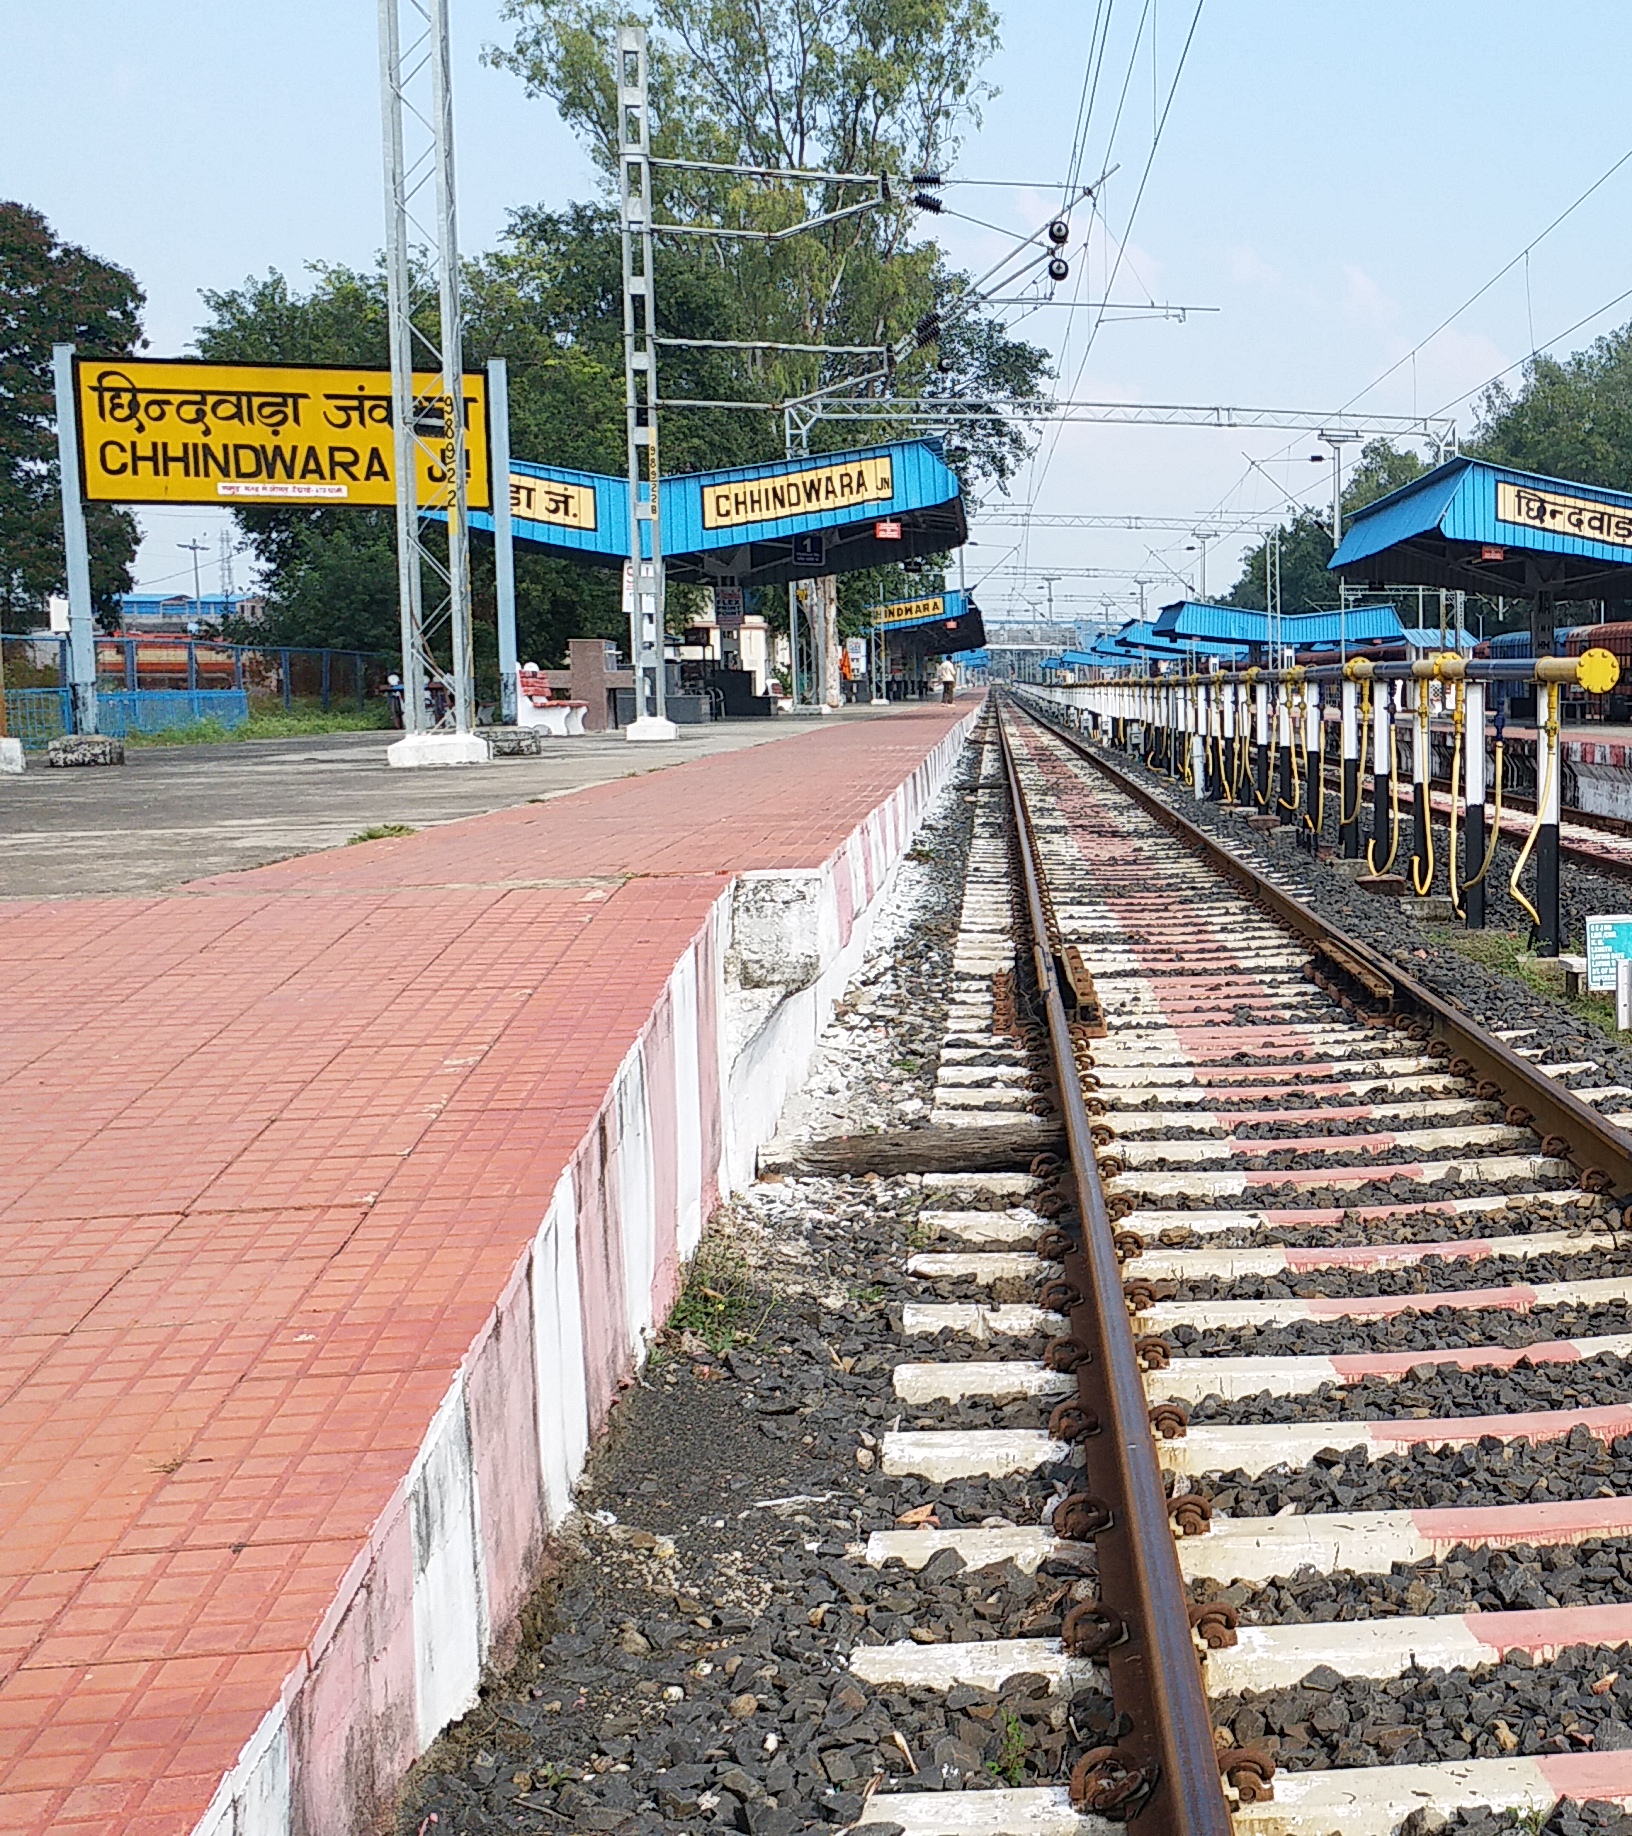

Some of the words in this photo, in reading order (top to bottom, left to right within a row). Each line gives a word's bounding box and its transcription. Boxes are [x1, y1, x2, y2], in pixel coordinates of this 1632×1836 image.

[88, 370, 311, 437] छिन्दवाड़ा
[100, 440, 391, 482] CHHINDWARA
[715, 470, 868, 518] CHHINDWARA
[802, 537, 812, 553] 1
